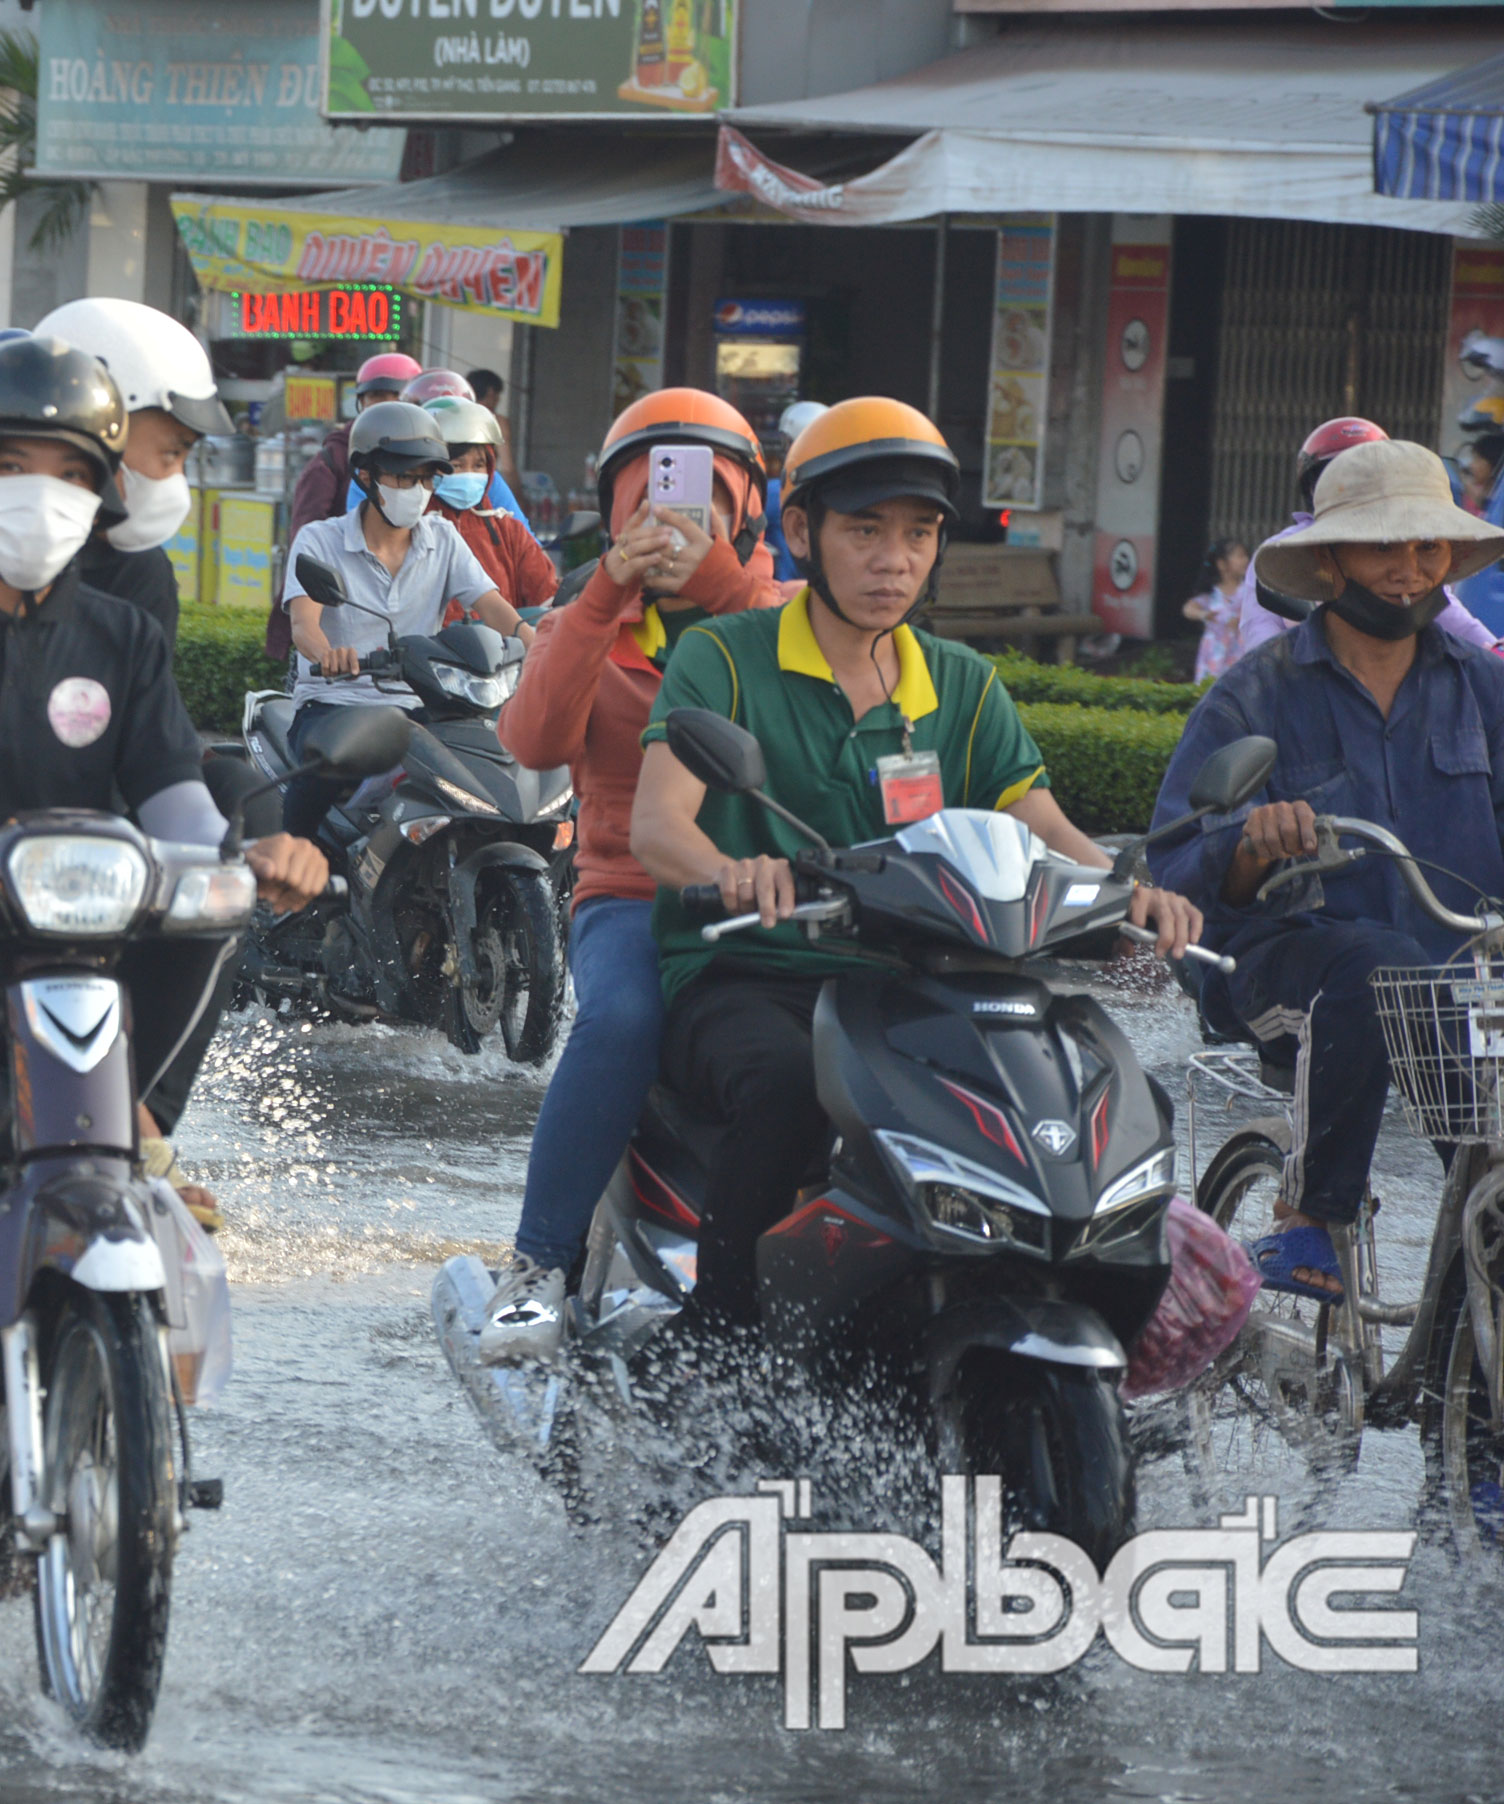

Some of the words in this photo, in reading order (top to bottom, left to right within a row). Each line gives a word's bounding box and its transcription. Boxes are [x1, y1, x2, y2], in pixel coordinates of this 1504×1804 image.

[434, 30, 481, 67] (NHÀ
[484, 31, 530, 68] LÀM)
[49, 49, 155, 102] HOÀNG
[164, 53, 270, 116] THIỆN
[328, 290, 390, 334] BAO
[973, 1001, 1036, 1015] HONDA
